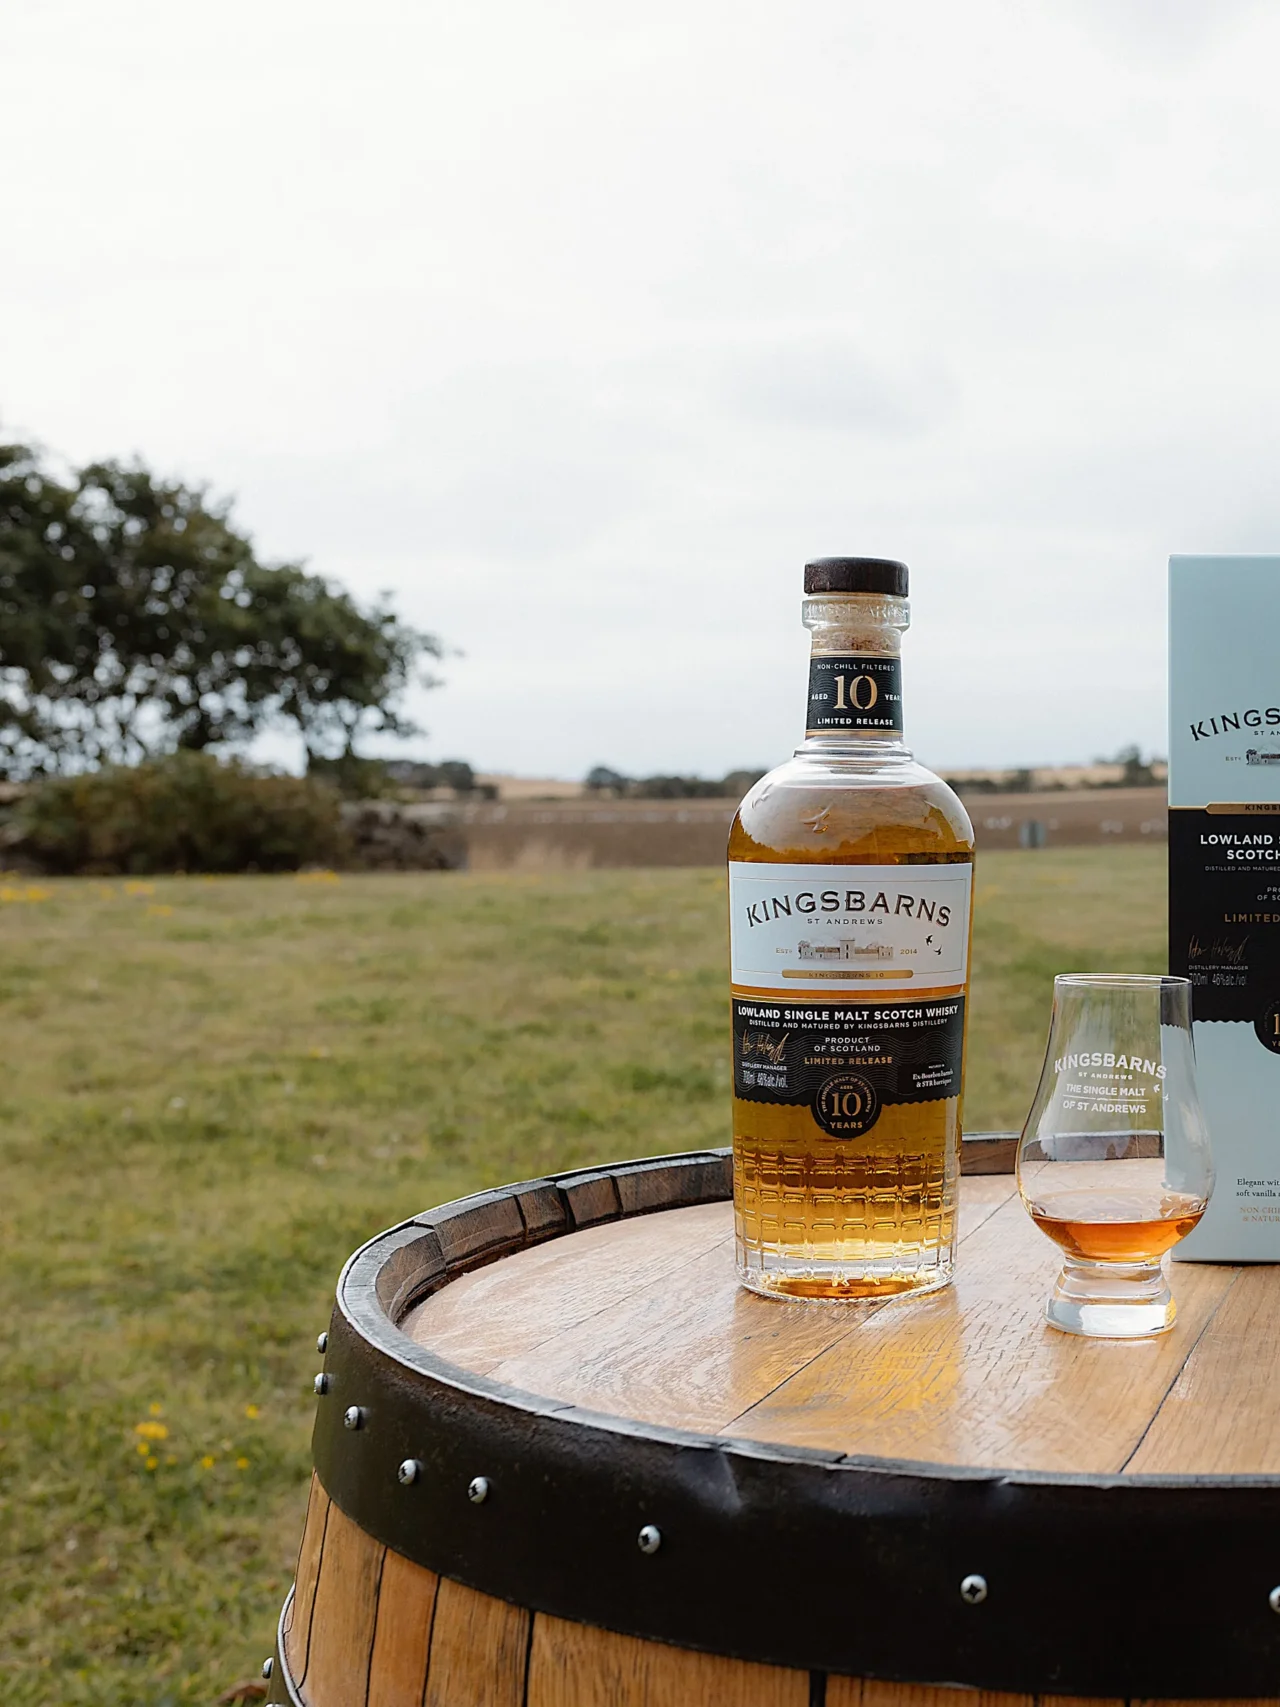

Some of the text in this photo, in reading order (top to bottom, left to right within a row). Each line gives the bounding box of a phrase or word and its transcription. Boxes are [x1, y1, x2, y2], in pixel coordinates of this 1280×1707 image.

[833, 675, 878, 710] 10
[1200, 834, 1273, 846] LOWLAND
[746, 890, 952, 927] KINGSBARNS
[1224, 913, 1280, 923] LIMITED
[738, 1004, 959, 1021] LOWLAND SINGLE MALT SCOTCH WHISKY
[749, 1020, 780, 1028] DISTILLED
[858, 1021, 910, 1030] KINGSBARNS
[913, 1018, 948, 1028] DISTILLERY
[825, 1036, 870, 1044] PRODUCT
[831, 1044, 880, 1052] SCOTLAND
[804, 1057, 893, 1065] LIMITED RELEASE
[1054, 1052, 1167, 1080] KINGSBARNS
[1091, 1072, 1132, 1080] ANDREWS
[1066, 1084, 1146, 1096] THE SINGLE MALT
[832, 1092, 861, 1116] 10
[1062, 1101, 1146, 1114] OF ST ANDREWS
[1237, 1178, 1265, 1187] Elegant
